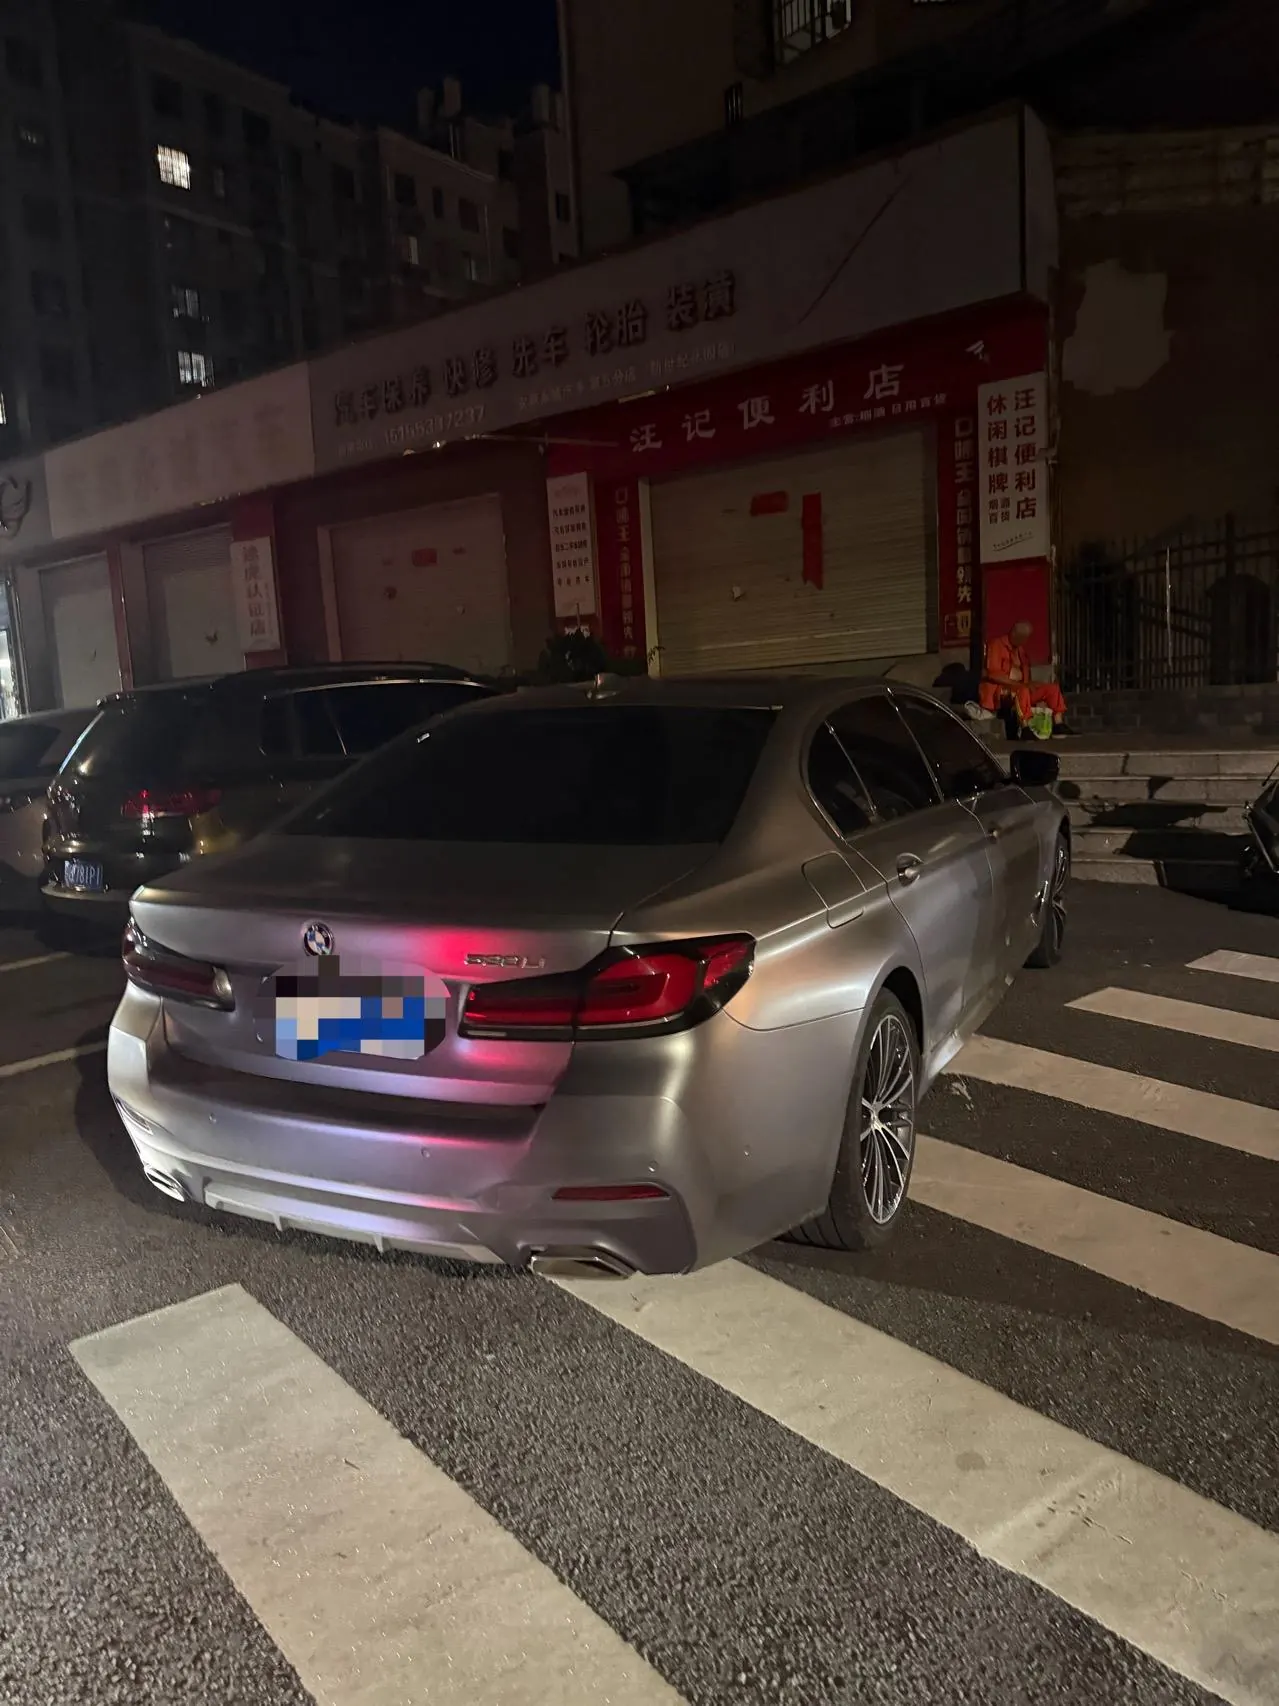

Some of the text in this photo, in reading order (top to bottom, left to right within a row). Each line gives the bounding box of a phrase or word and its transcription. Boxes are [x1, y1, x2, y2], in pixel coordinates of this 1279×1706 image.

[512, 326, 568, 378] 洗车
[585, 299, 648, 356] 轮胎
[630, 363, 905, 453] 汪记便利店
[986, 393, 1010, 494] 休闲棋牌
[1013, 387, 1038, 519] 汪记便利店
